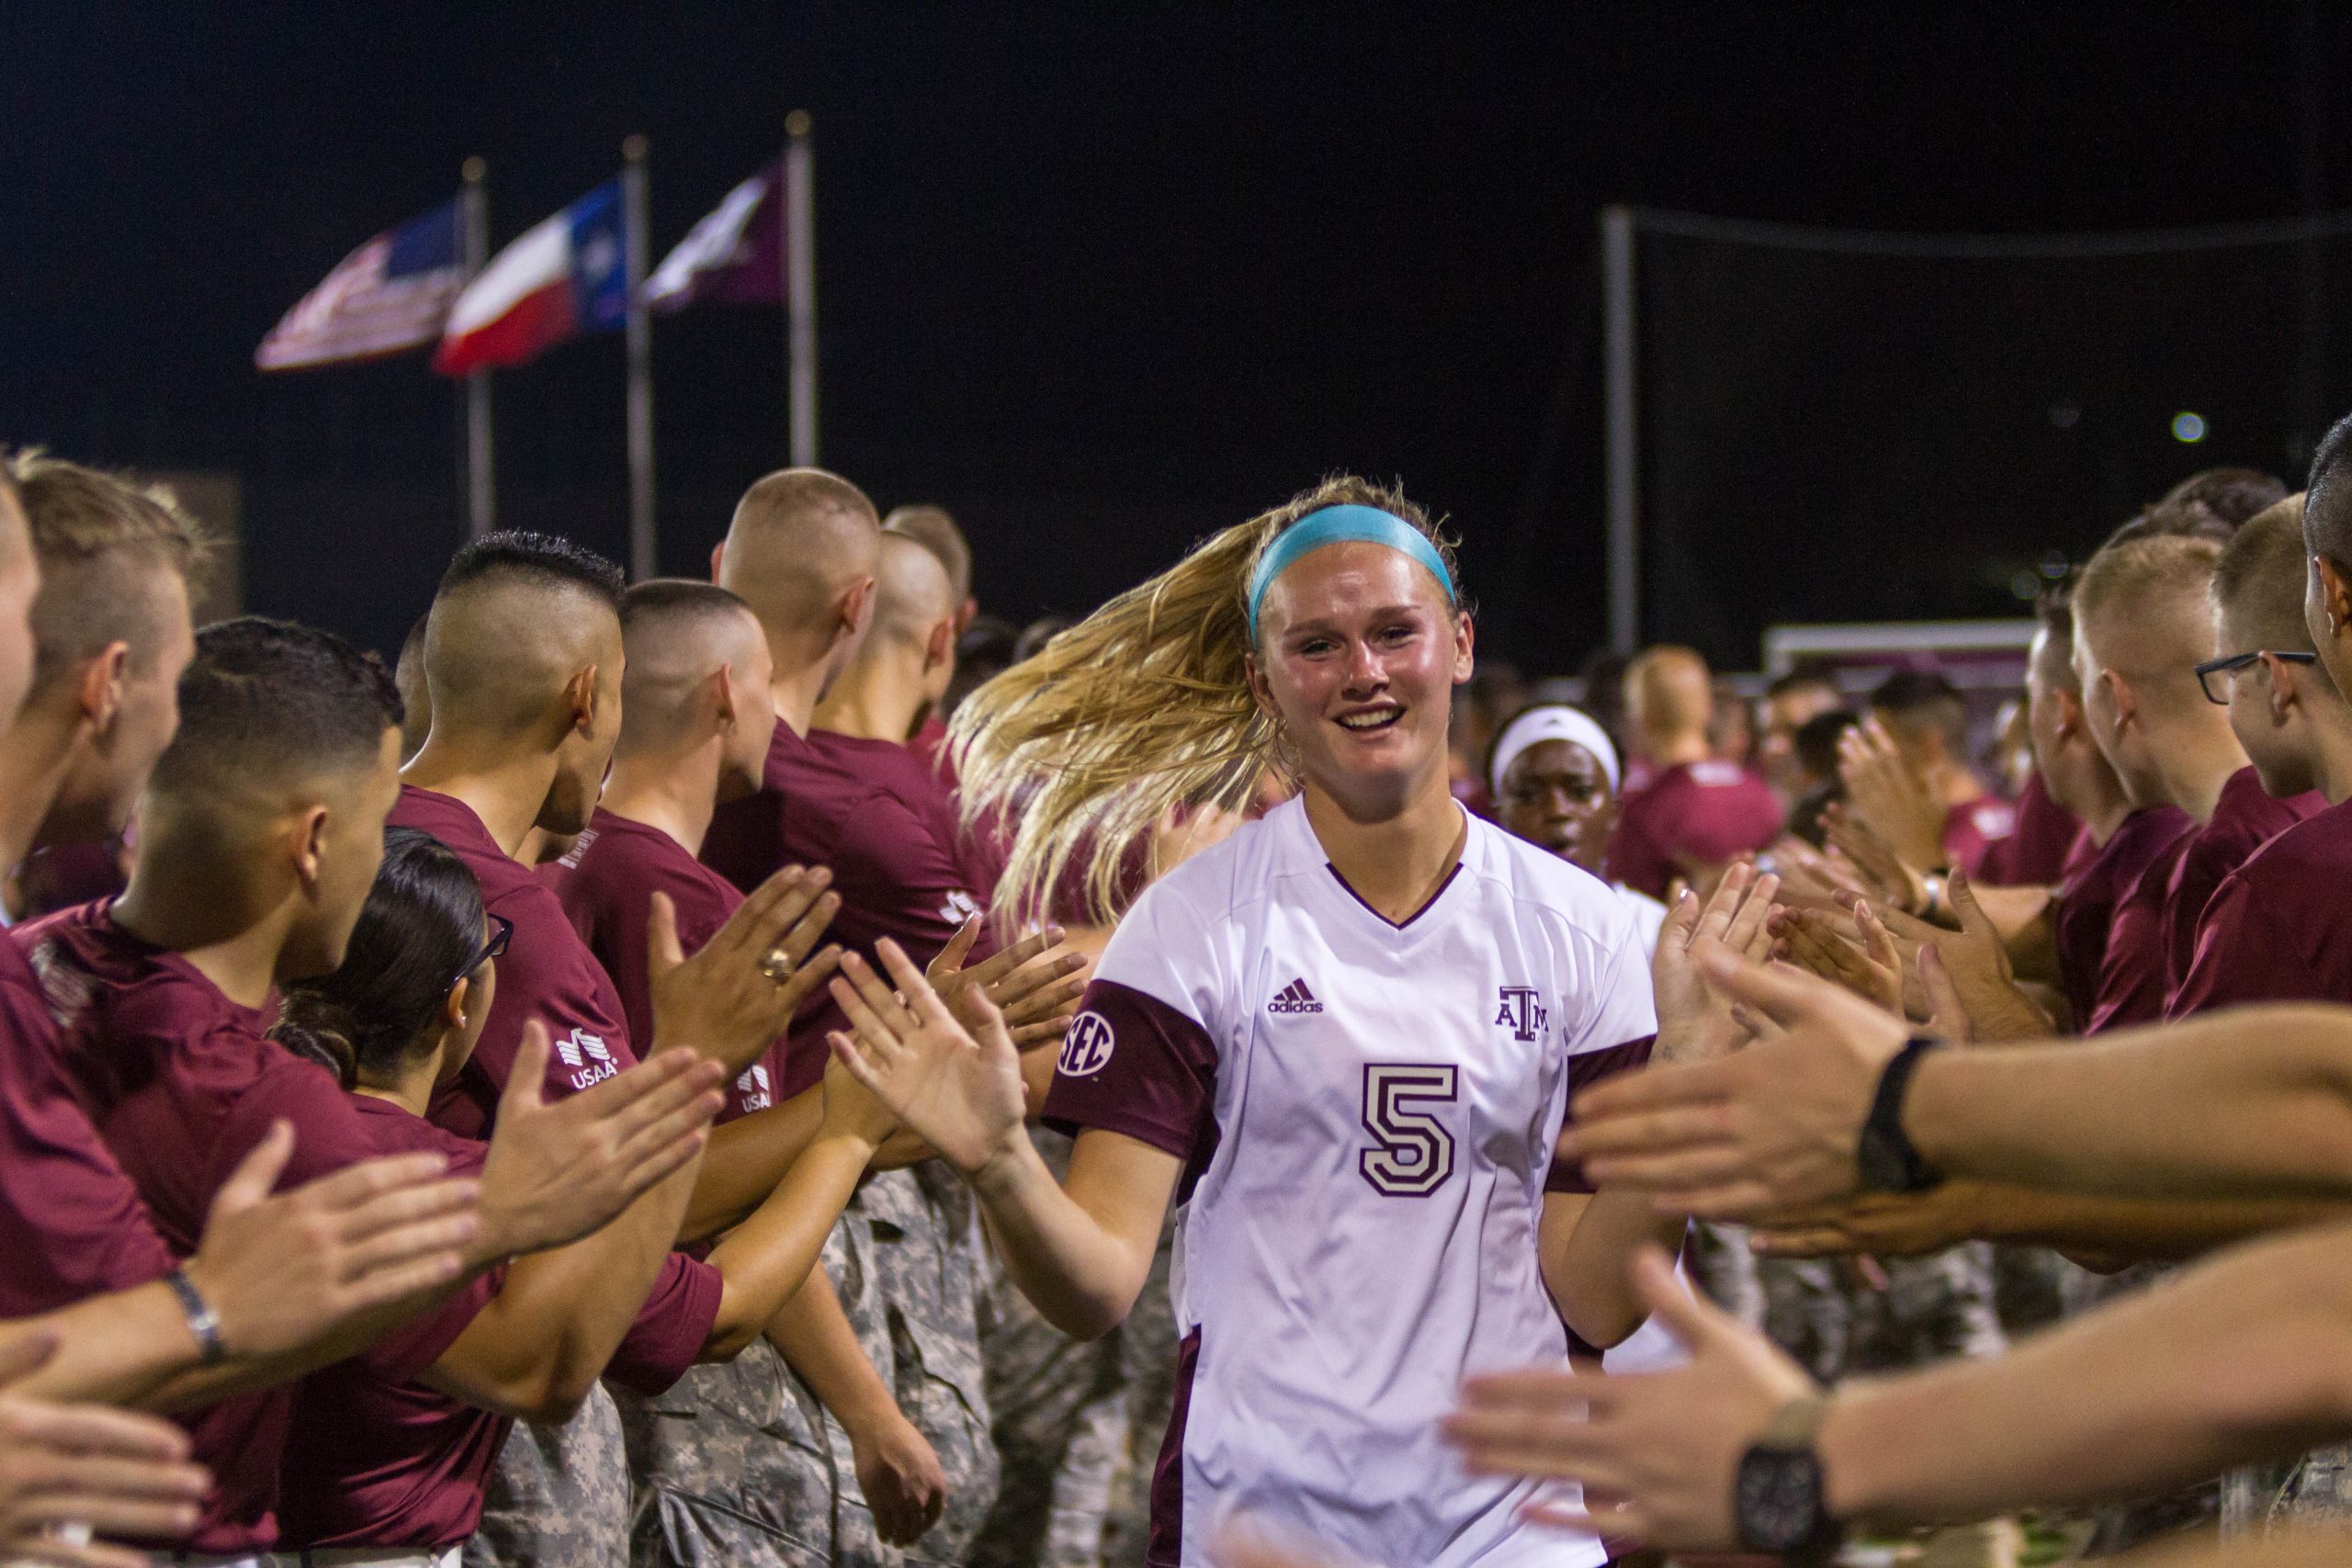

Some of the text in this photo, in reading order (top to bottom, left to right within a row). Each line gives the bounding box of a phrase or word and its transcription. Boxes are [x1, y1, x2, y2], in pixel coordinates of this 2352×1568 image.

[1267, 1000, 1323, 1013] adidas
[1059, 1015, 1110, 1072] SEC
[571, 1061, 617, 1089] USAA
[1359, 1063, 1458, 1198] 5
